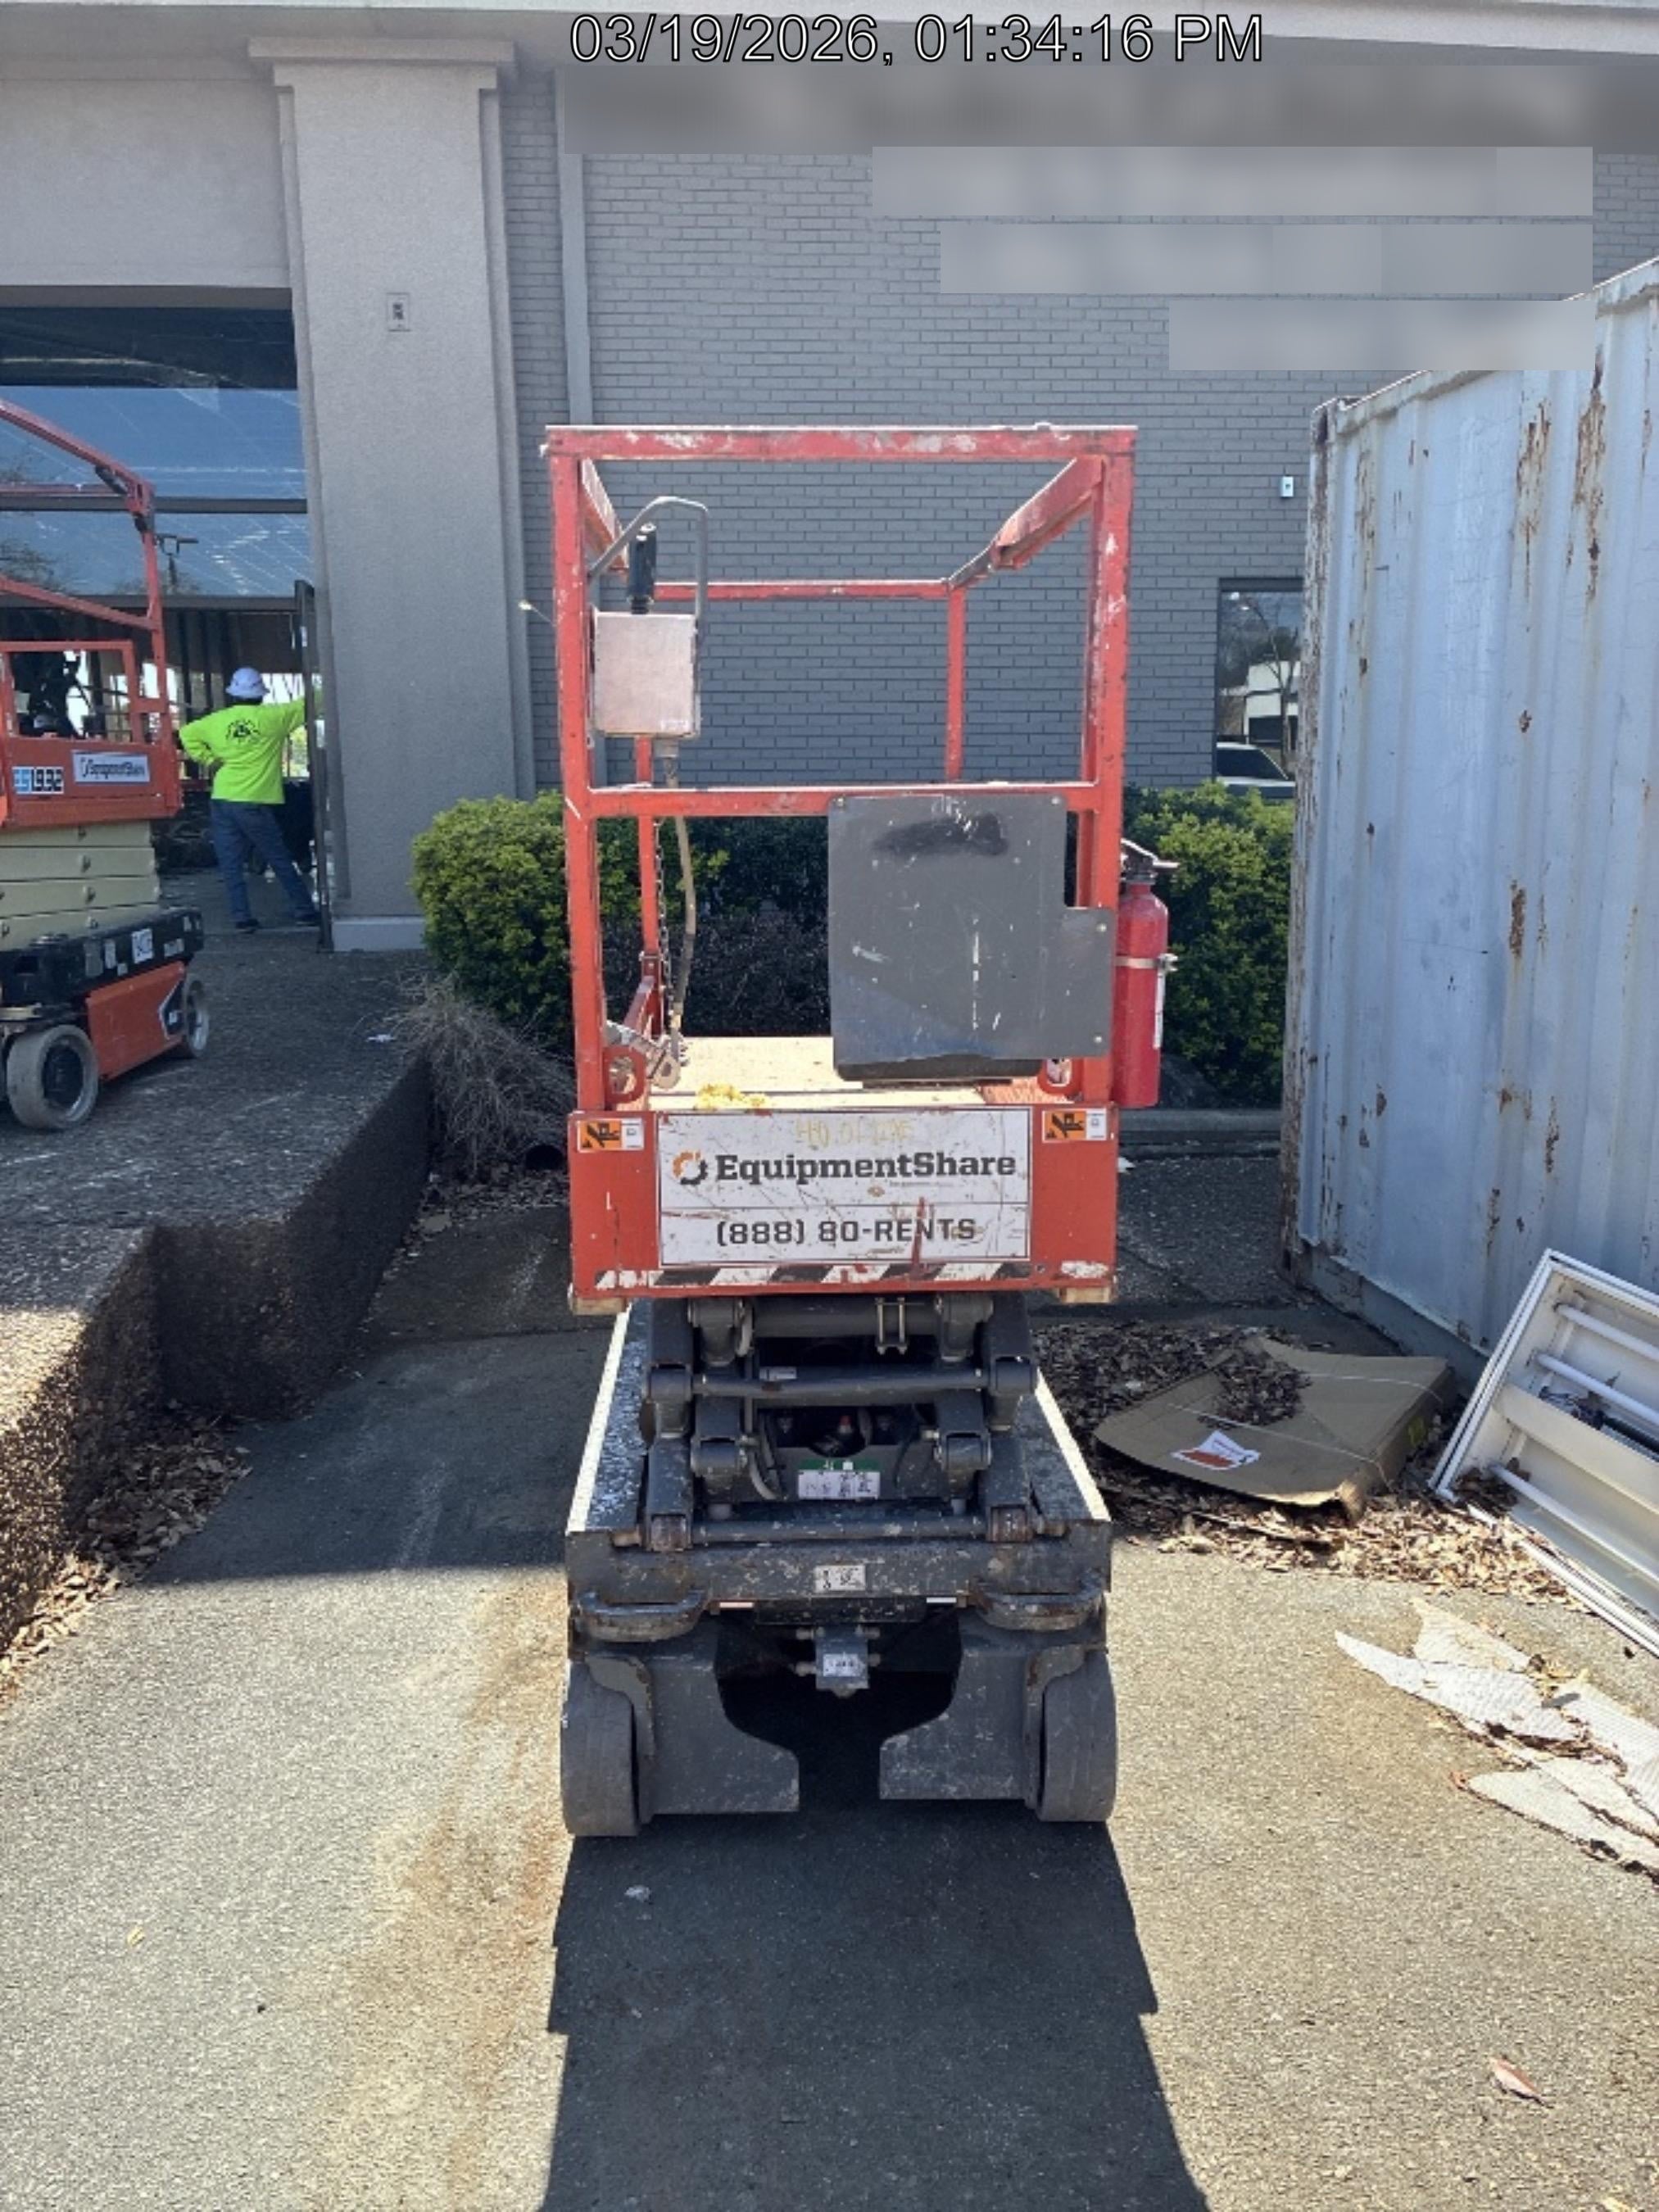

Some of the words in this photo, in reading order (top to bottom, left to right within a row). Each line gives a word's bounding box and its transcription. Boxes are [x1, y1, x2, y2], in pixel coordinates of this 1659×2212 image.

[715, 1152, 1015, 1185] EquipmentShare
[717, 1221, 805, 1245] (888)
[818, 1217, 977, 1244] 80-RENTS
